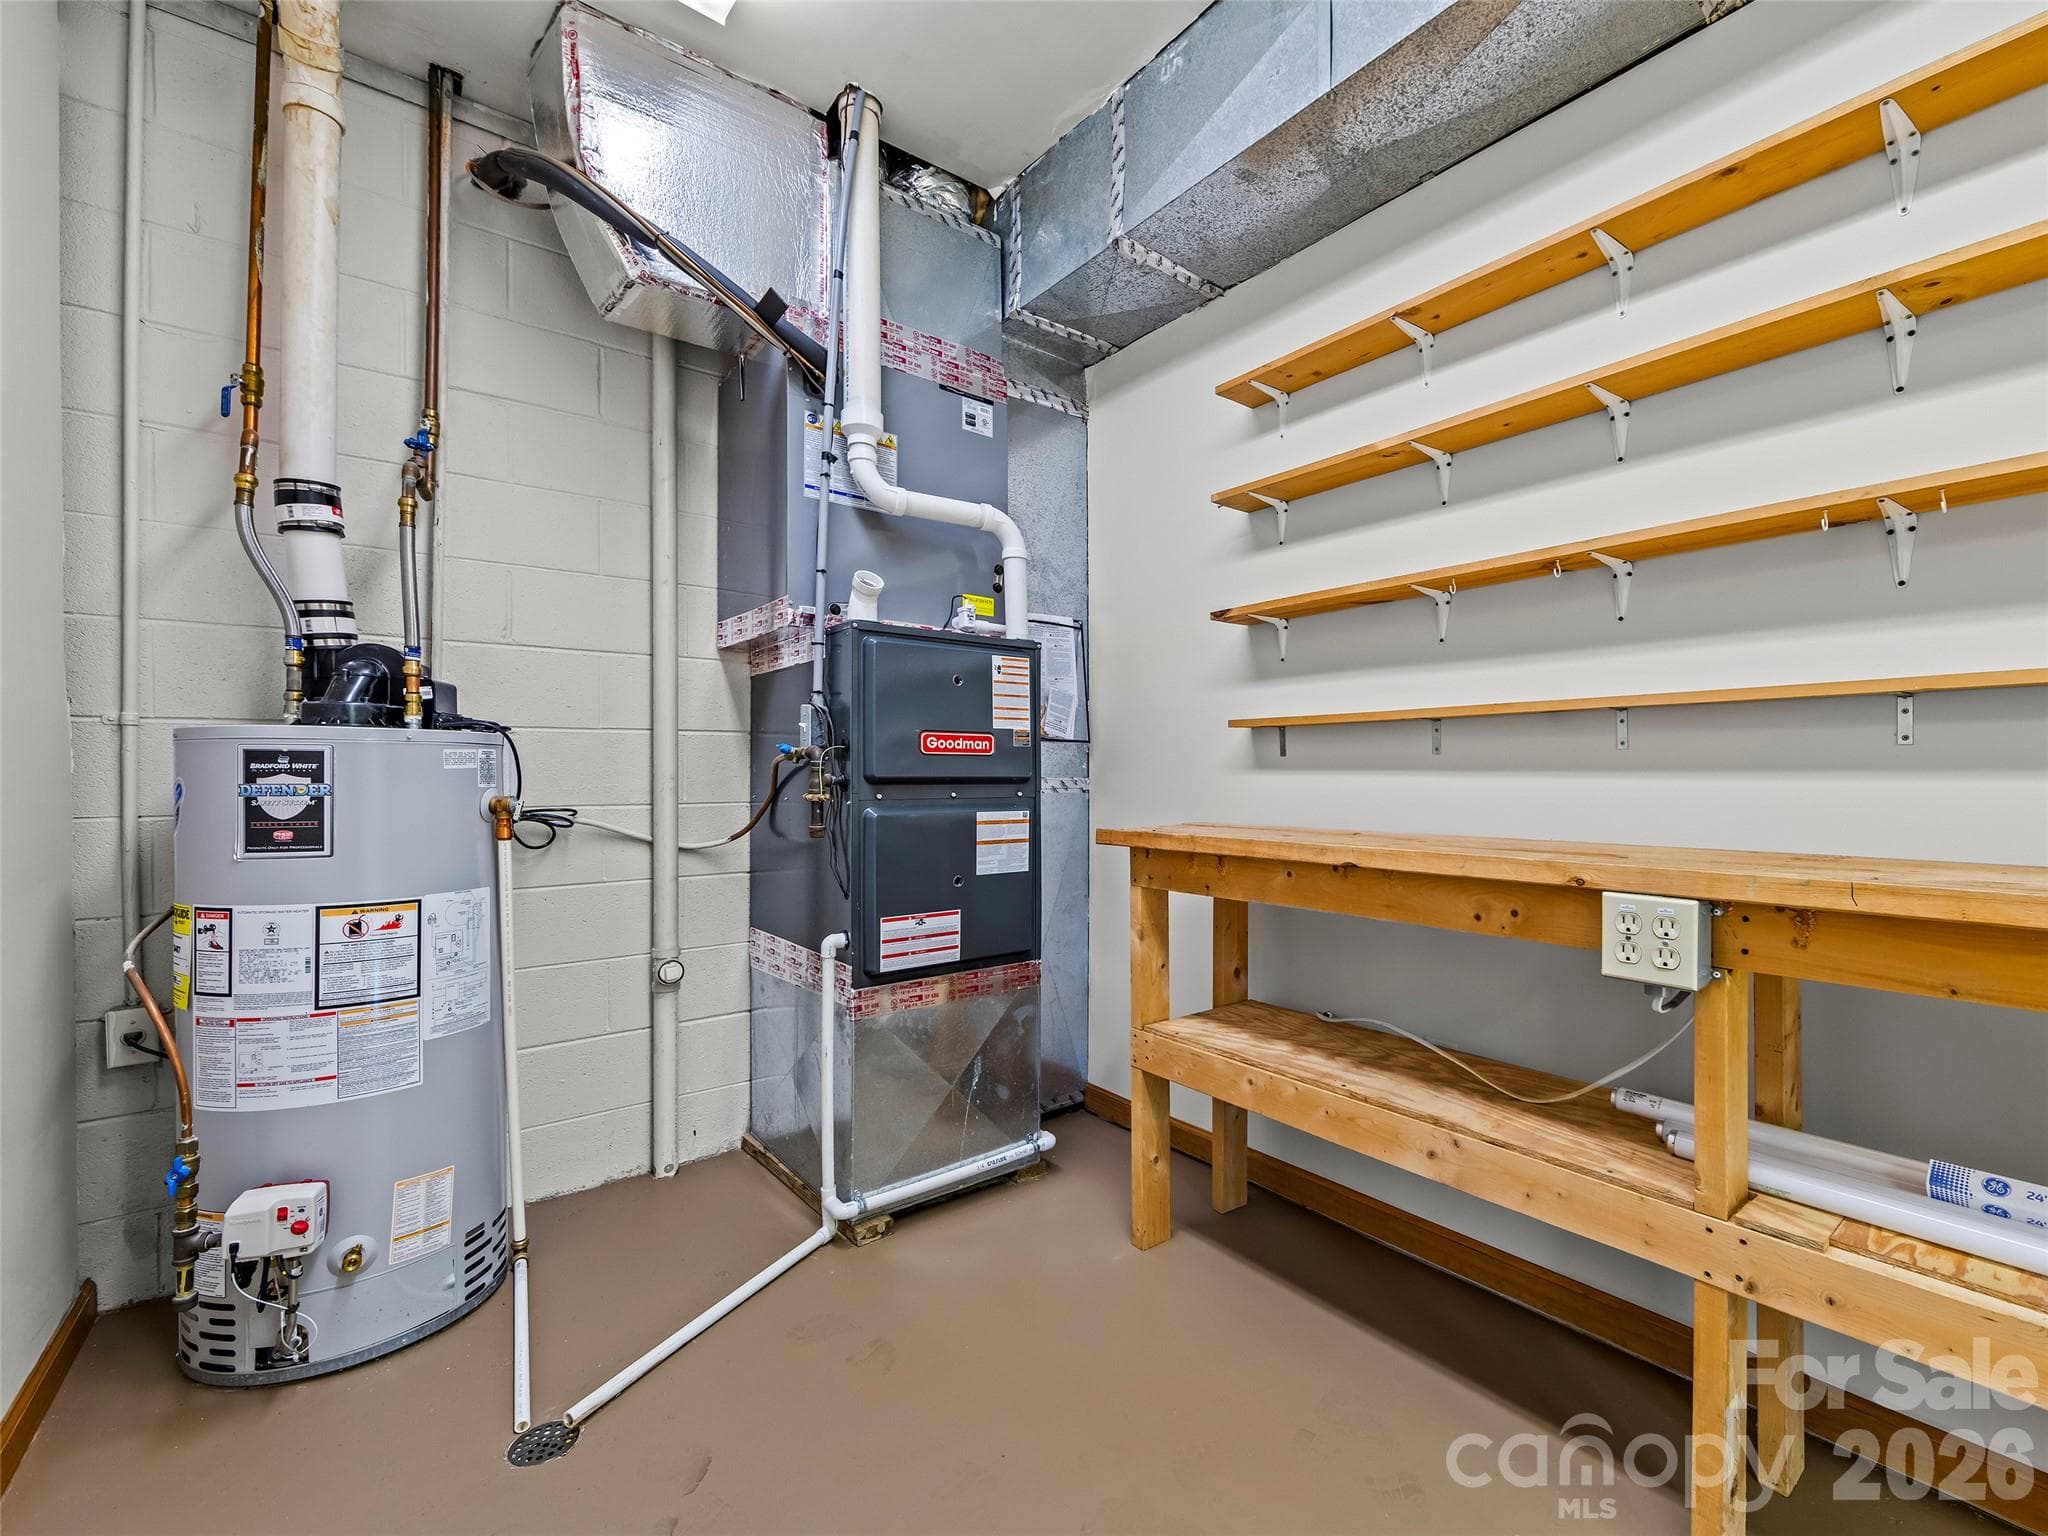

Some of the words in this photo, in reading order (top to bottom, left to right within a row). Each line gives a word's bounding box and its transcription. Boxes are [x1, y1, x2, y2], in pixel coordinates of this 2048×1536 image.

[926, 736, 990, 750] Goodman
[239, 784, 332, 798] DEFENDER
[360, 906, 389, 914] WARNING
